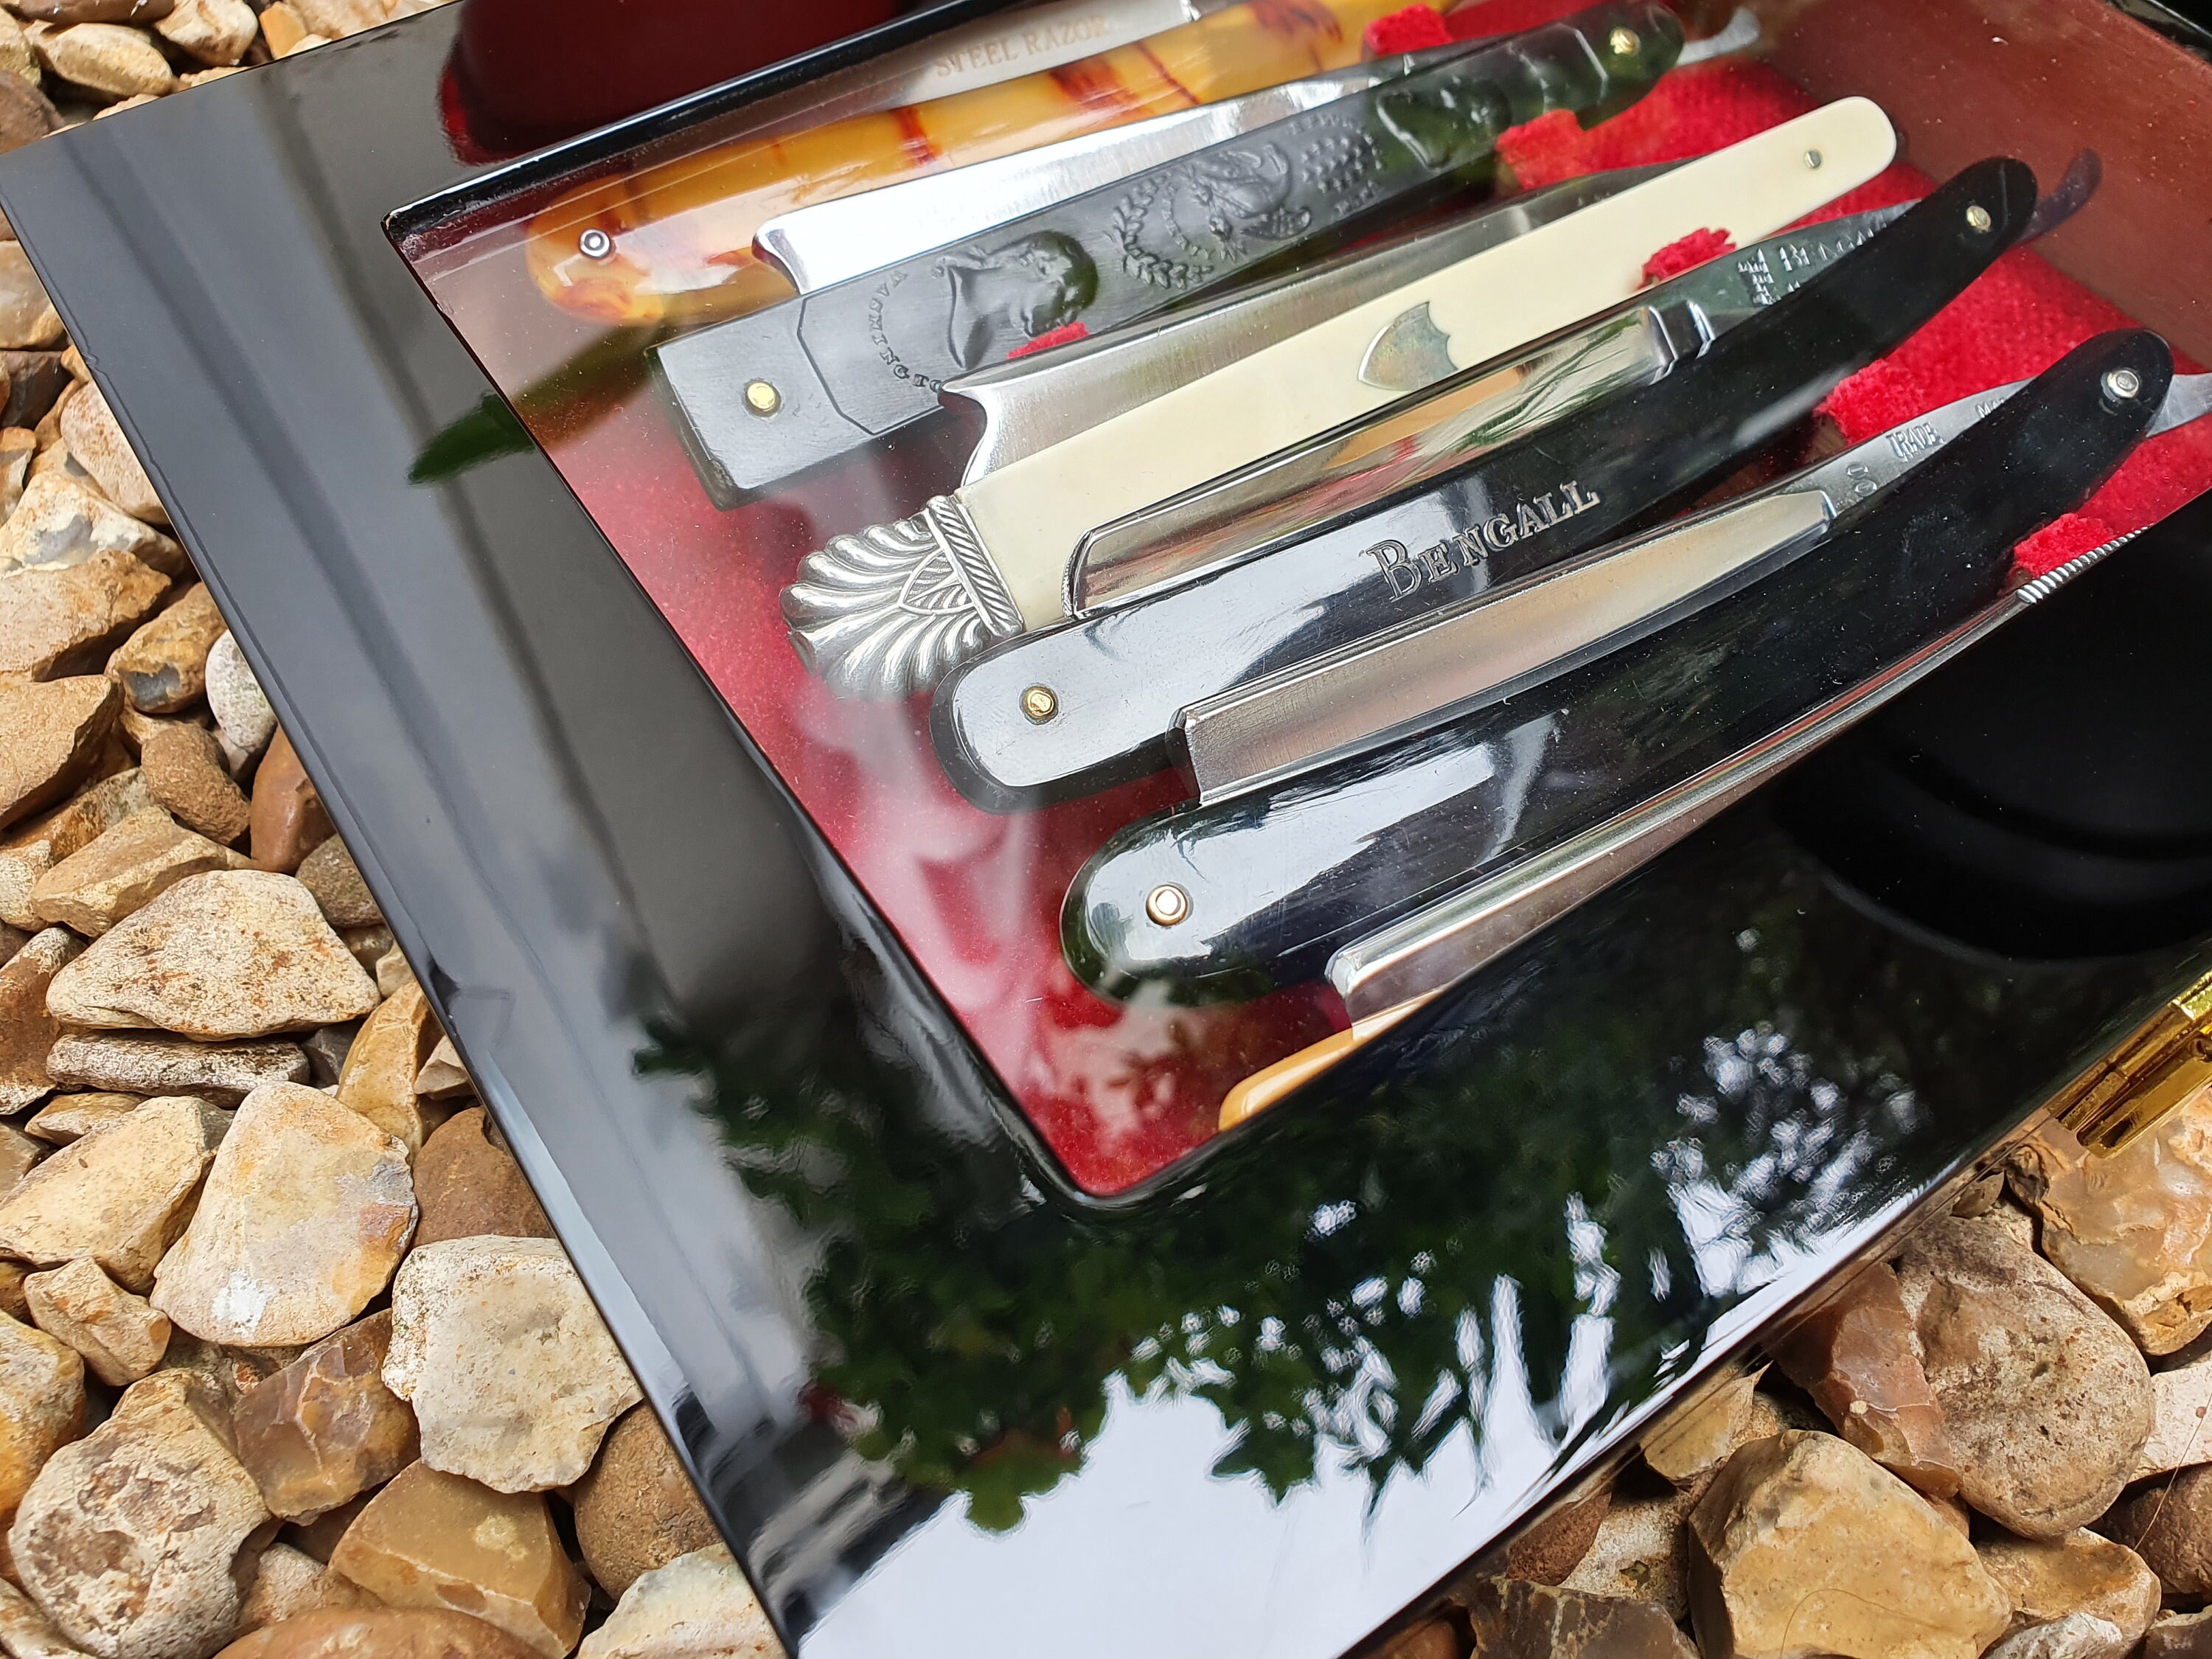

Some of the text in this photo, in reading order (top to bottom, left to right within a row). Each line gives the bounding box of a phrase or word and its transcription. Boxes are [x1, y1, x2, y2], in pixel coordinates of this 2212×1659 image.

[936, 15, 1109, 77] STEEL RAZOR
[869, 269, 943, 393] WASHINGTO
[1363, 480, 1601, 603] BENGALL
